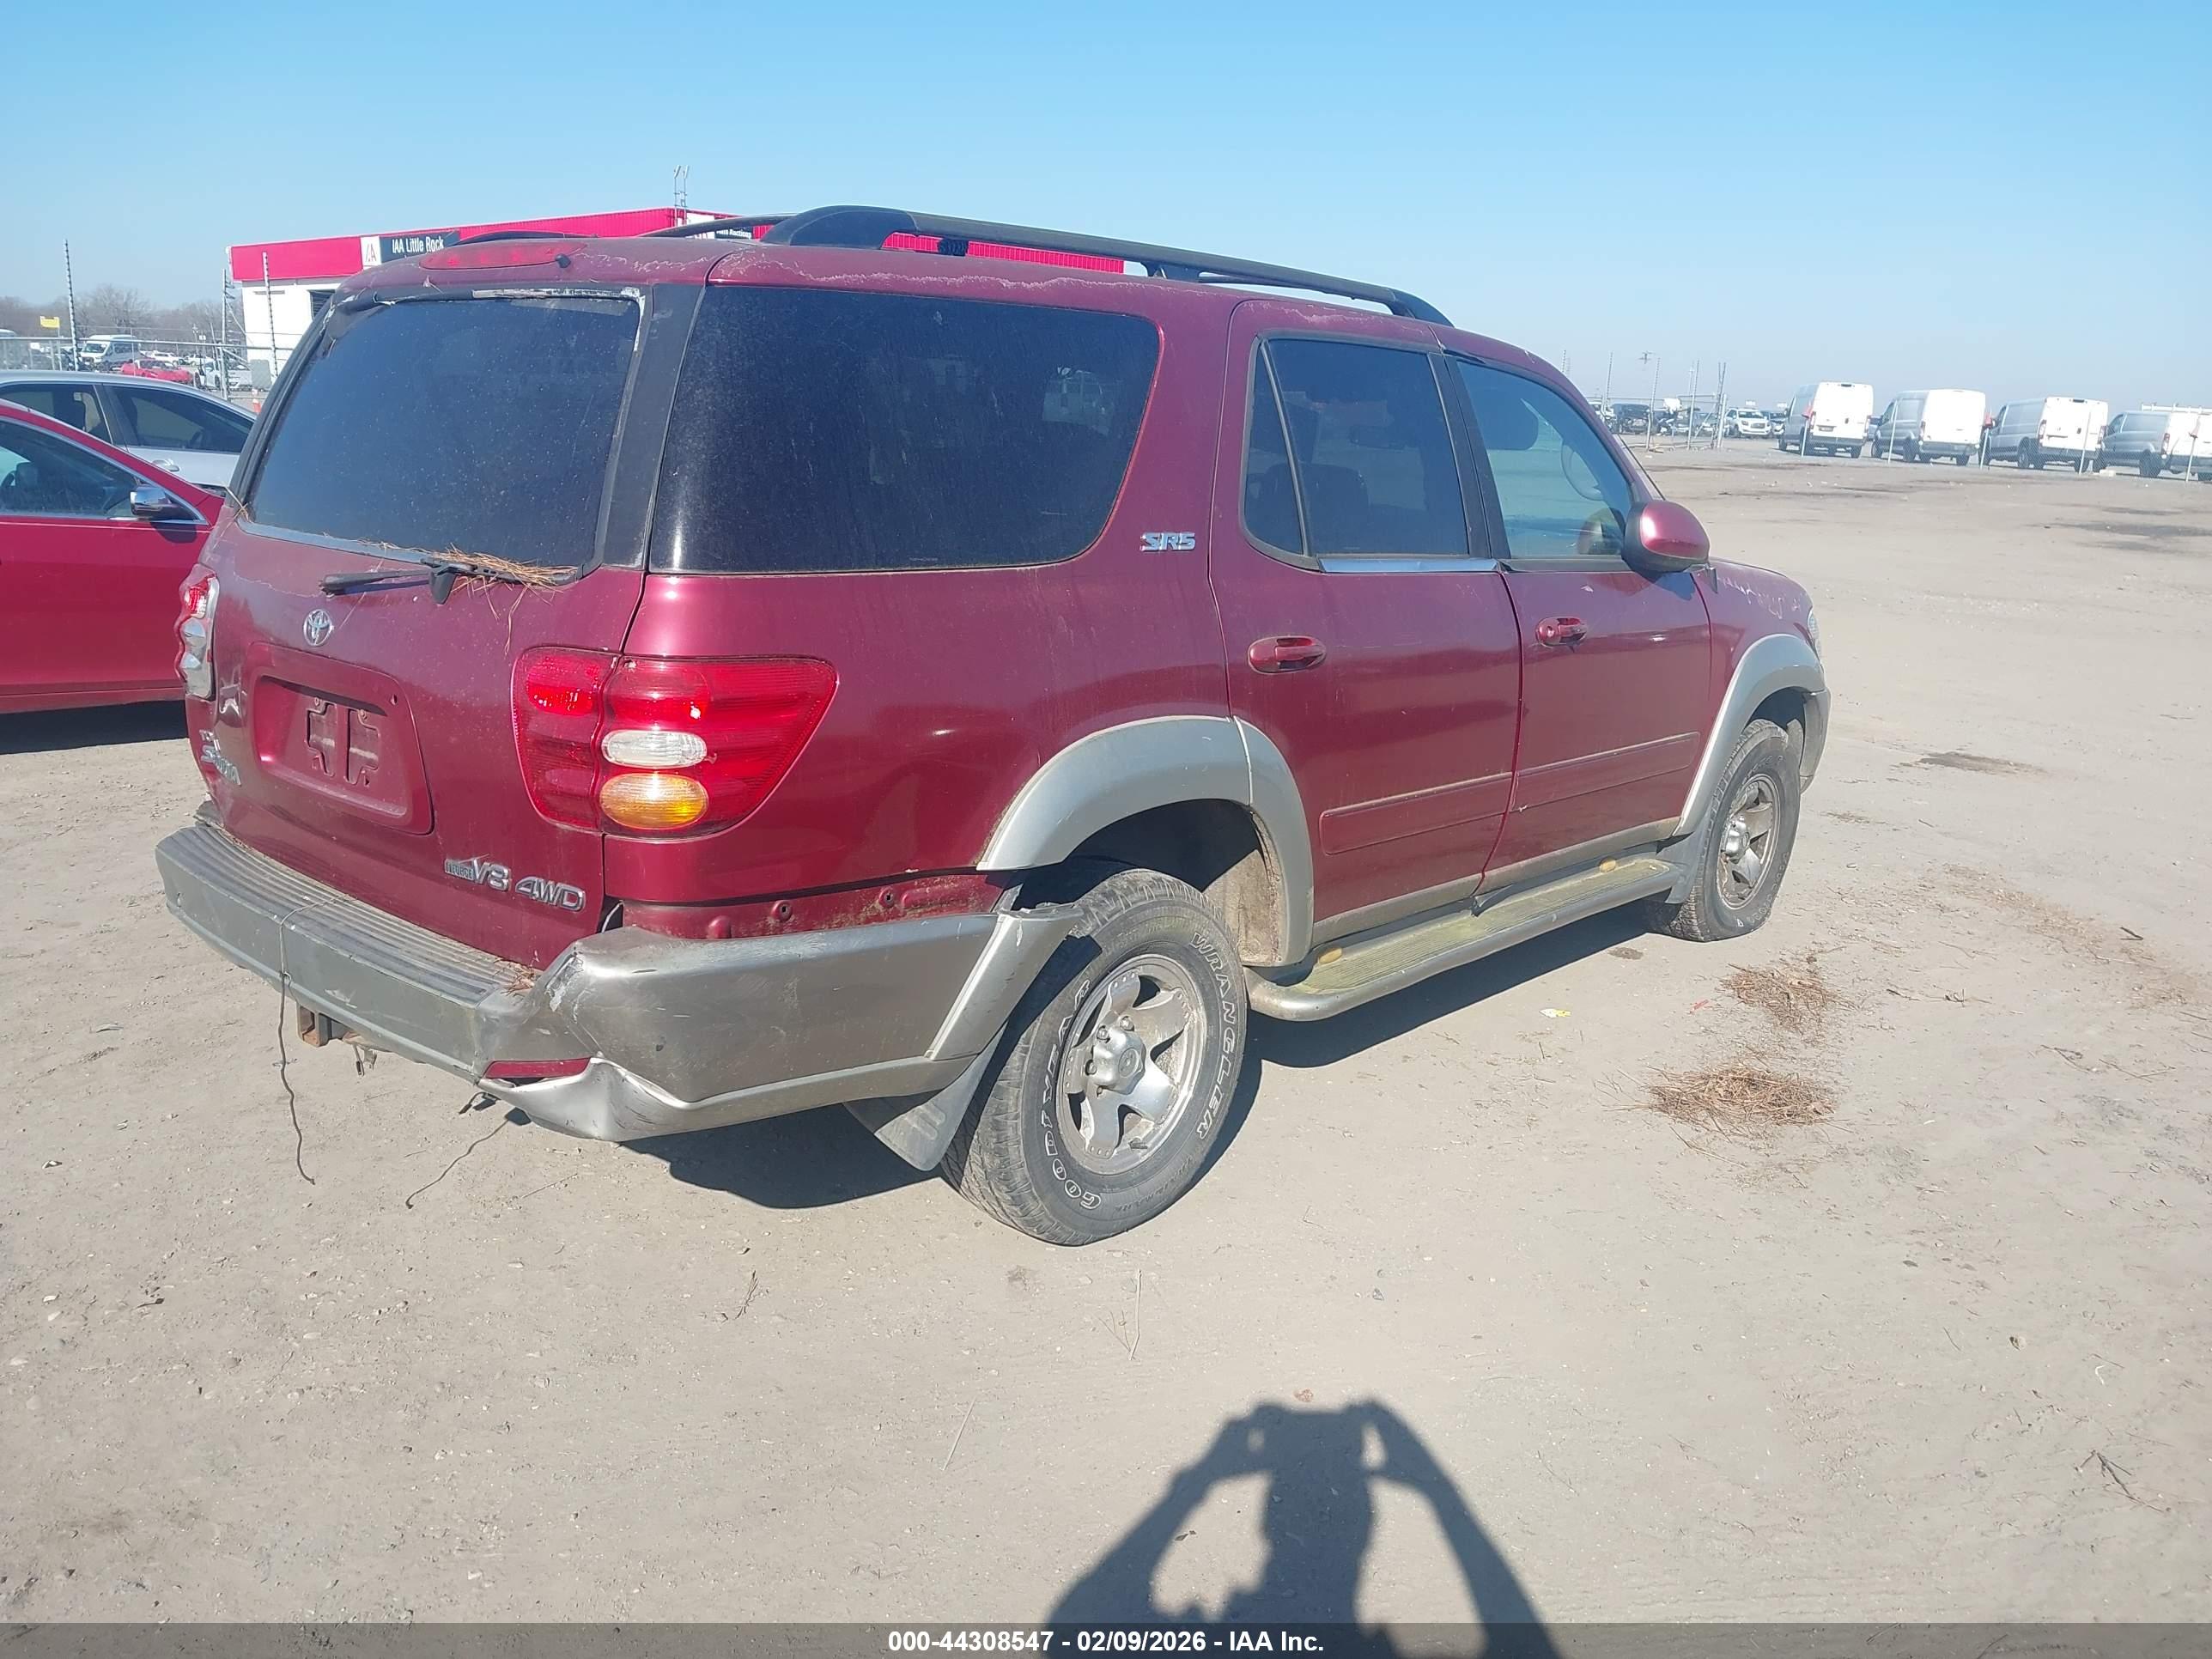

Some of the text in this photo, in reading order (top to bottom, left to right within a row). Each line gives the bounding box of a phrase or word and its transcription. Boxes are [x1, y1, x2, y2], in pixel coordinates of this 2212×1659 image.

[392, 234, 445, 254] IAA Little Rock
[1139, 532, 1195, 551] SR5
[472, 857, 512, 891] V8
[515, 876, 586, 912] 4WD
[1188, 932, 1237, 1139] WRANGLER
[1042, 980, 1102, 1209] GOODYEAR
